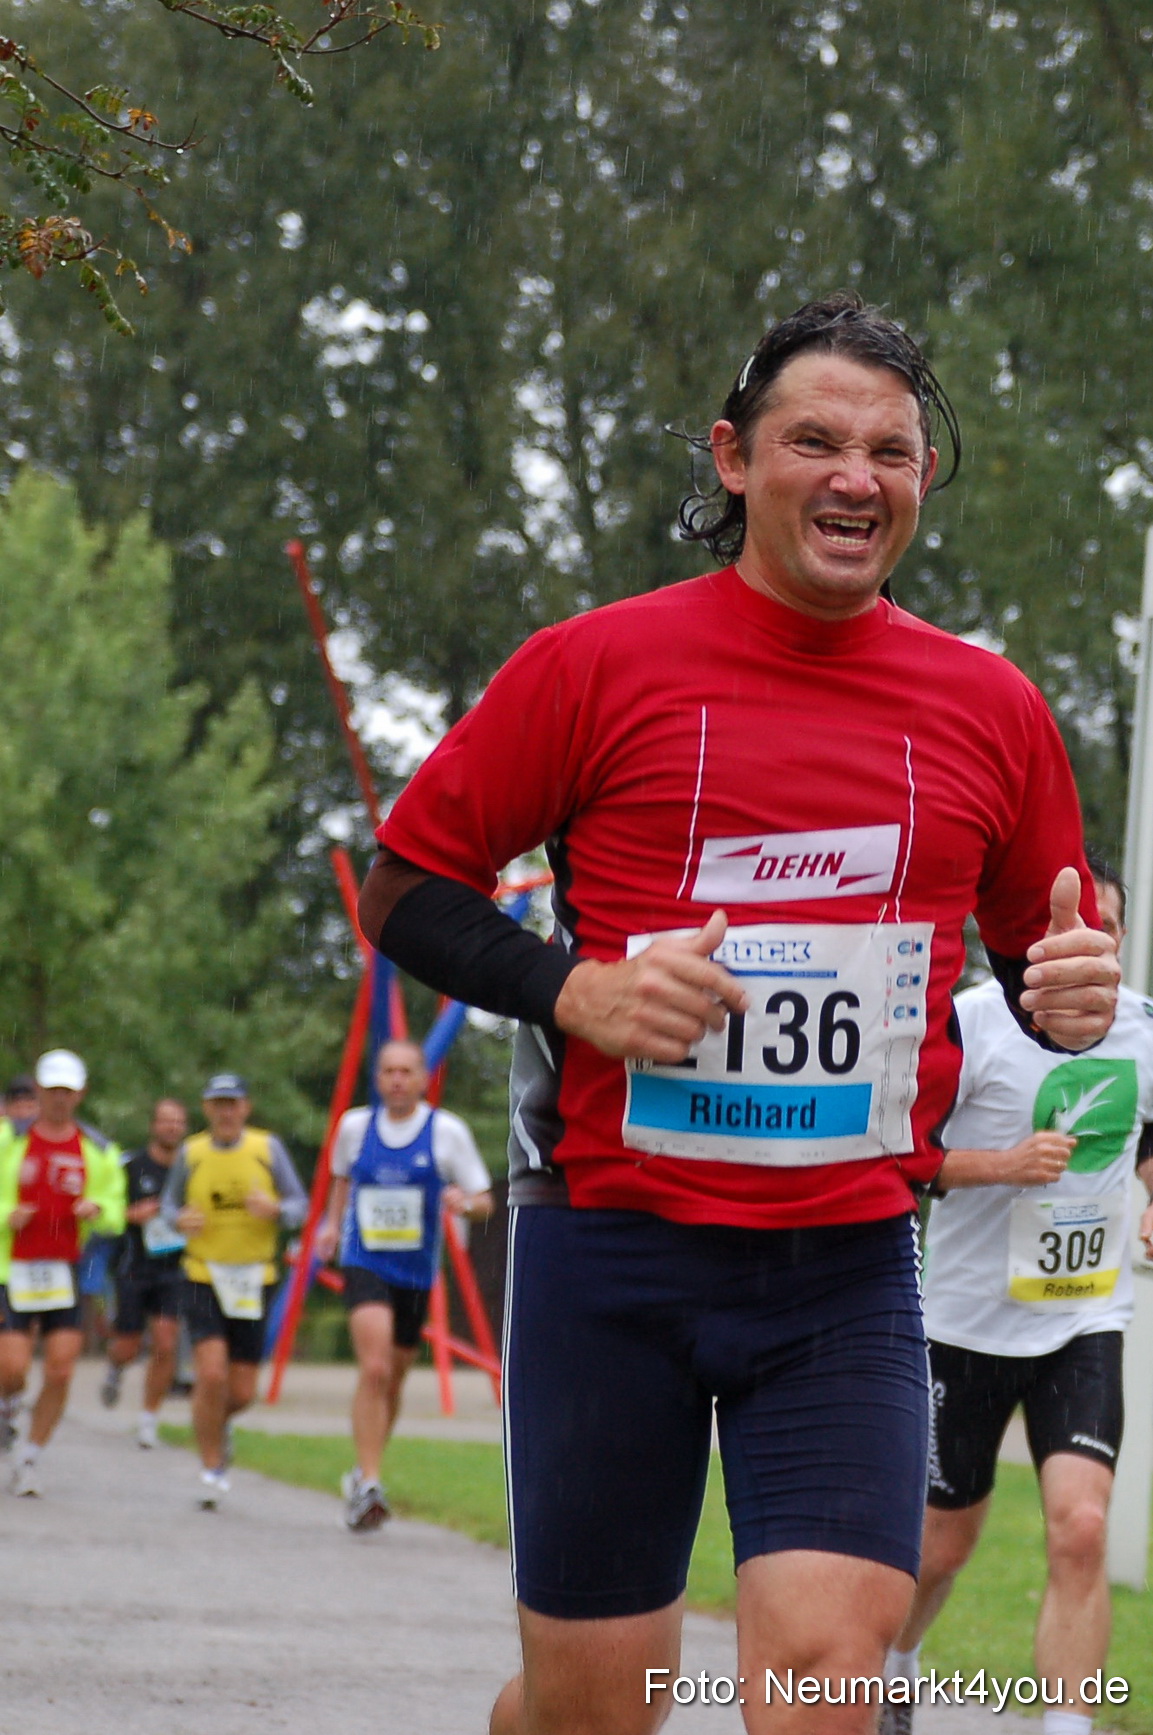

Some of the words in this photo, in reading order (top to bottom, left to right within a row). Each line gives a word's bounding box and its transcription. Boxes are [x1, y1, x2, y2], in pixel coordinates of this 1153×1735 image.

[752, 851, 846, 881] DEHN
[653, 990, 861, 1076] 136
[689, 1092, 817, 1130] Richard
[1038, 1227, 1105, 1275] 309
[1043, 1281, 1095, 1297] Robert
